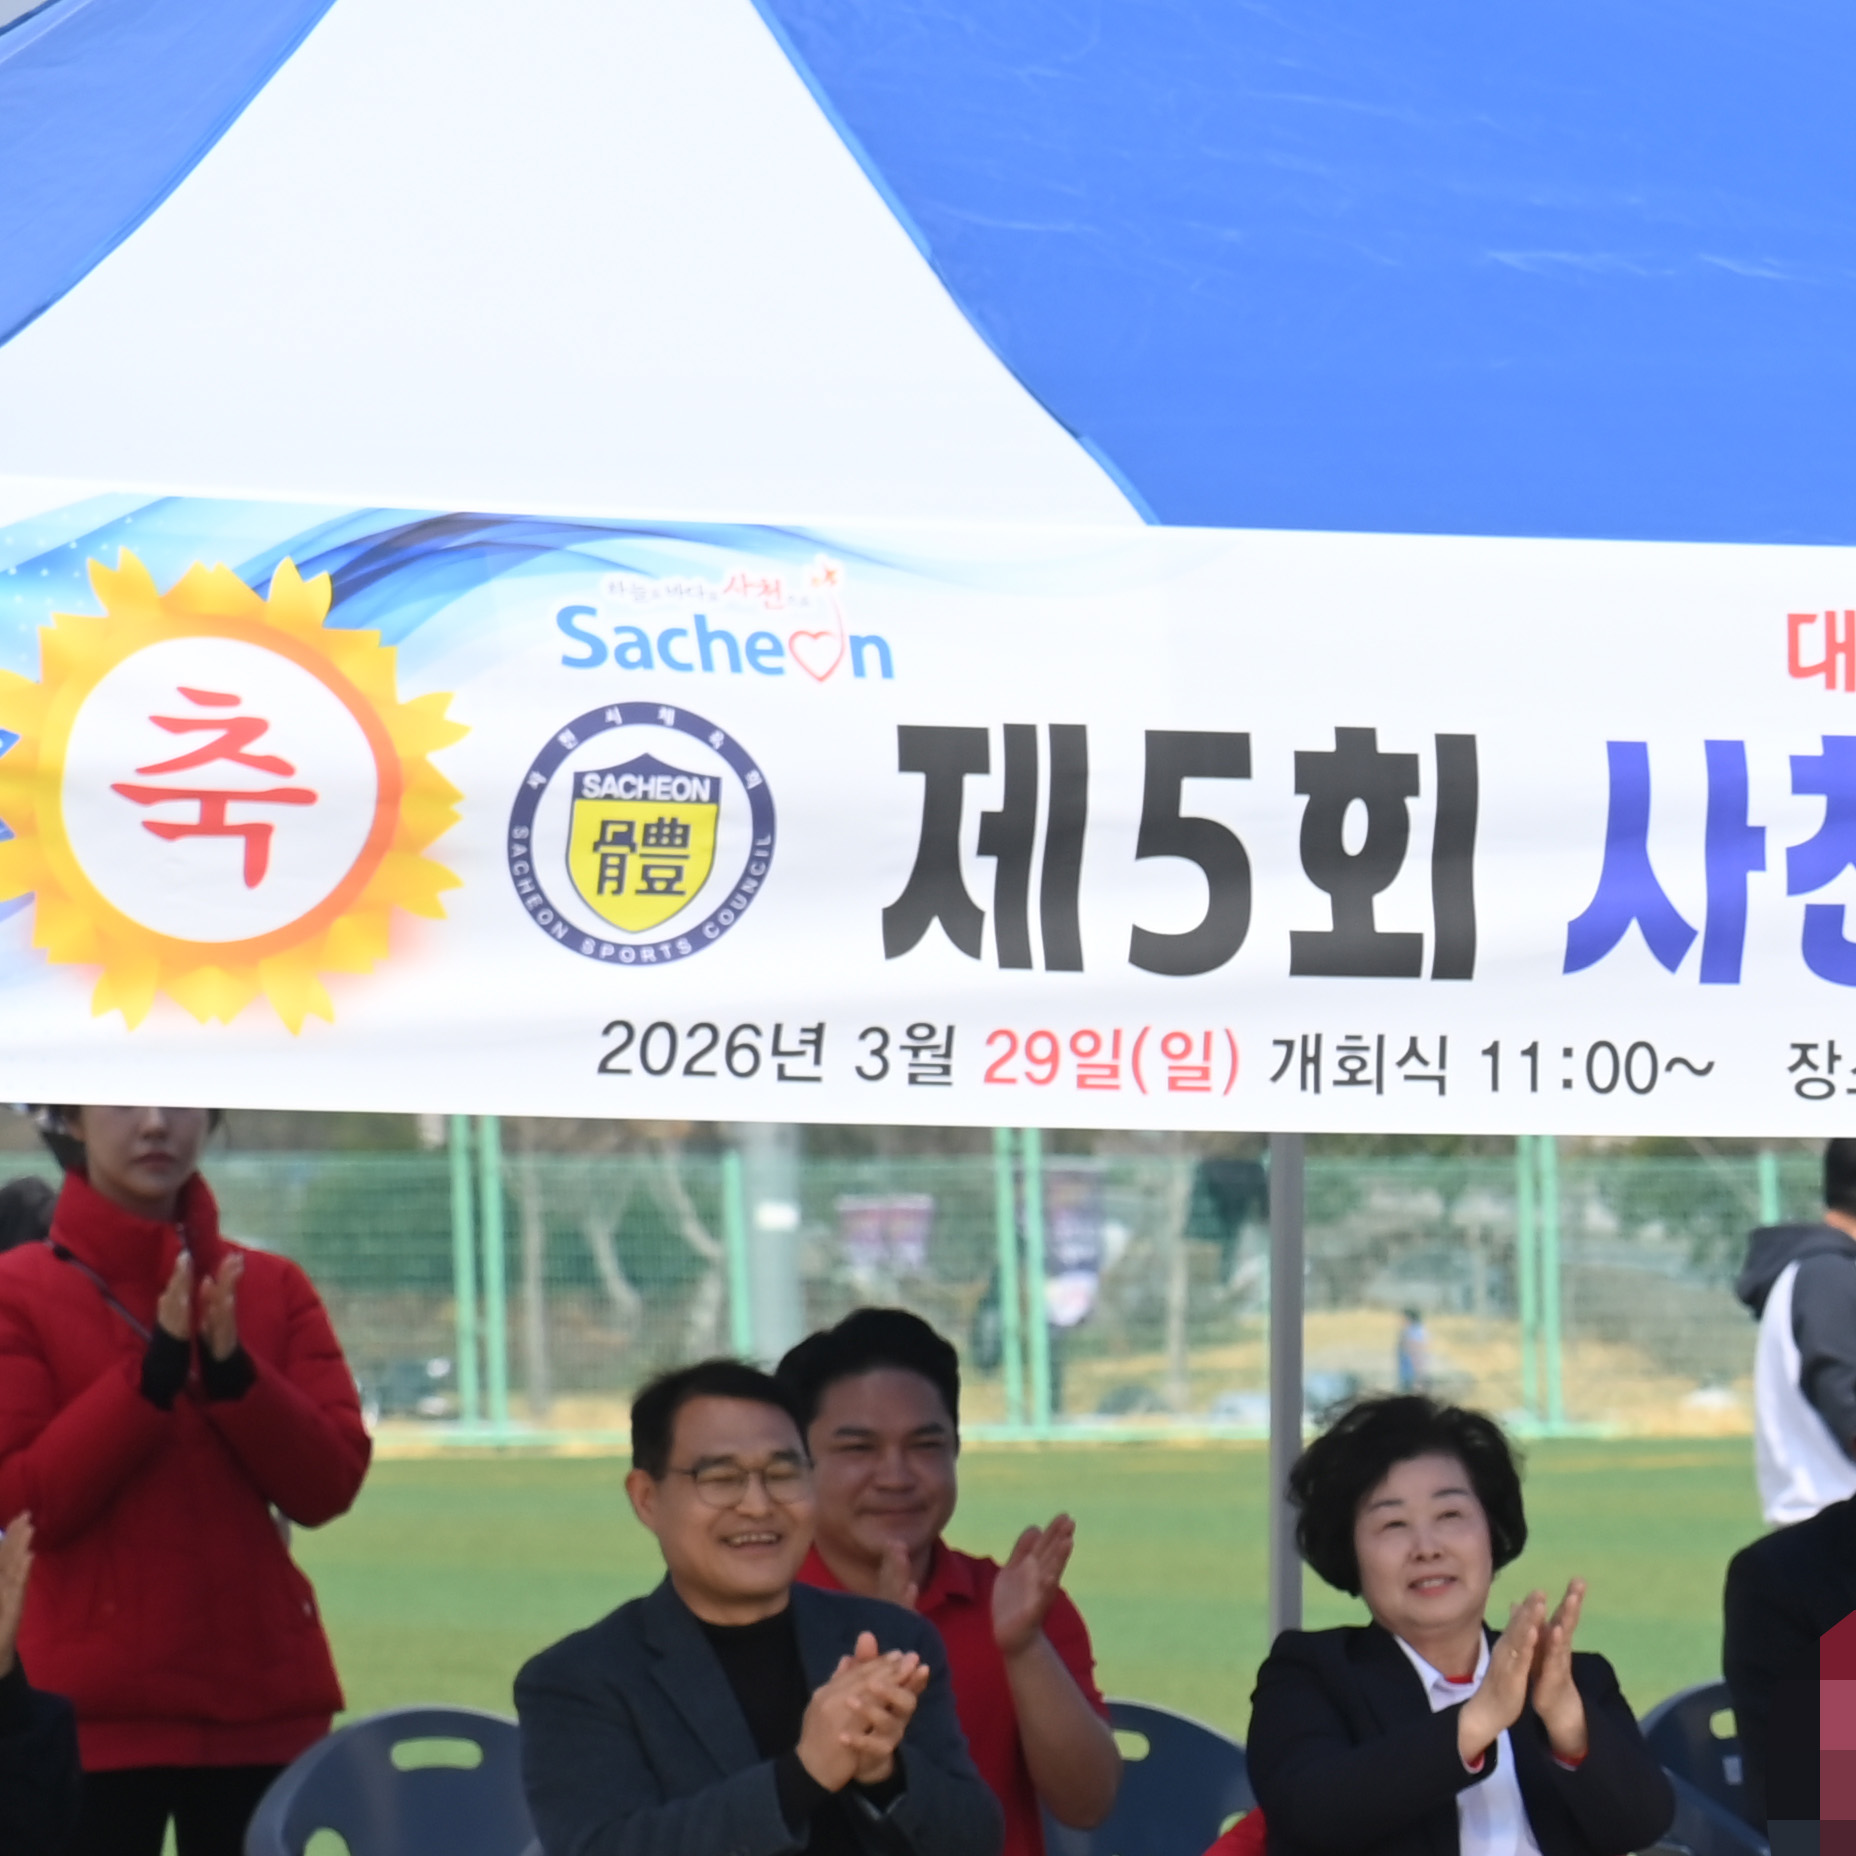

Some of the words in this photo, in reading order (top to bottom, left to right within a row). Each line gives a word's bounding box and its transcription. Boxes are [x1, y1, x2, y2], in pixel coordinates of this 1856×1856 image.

[111, 686, 318, 889] 축
[582, 772, 711, 802] SACHEON
[882, 723, 1479, 980] 제5회
[511, 825, 569, 940] SACHEON
[579, 937, 693, 963] SPORTS
[703, 834, 772, 939] COUNCIL
[597, 1020, 827, 1083] 2026년
[855, 1022, 956, 1087] 3월
[983, 1025, 1239, 1096] 29일(일)
[1269, 1032, 1448, 1097] 개회식
[1480, 1039, 1715, 1096] 11:00~
